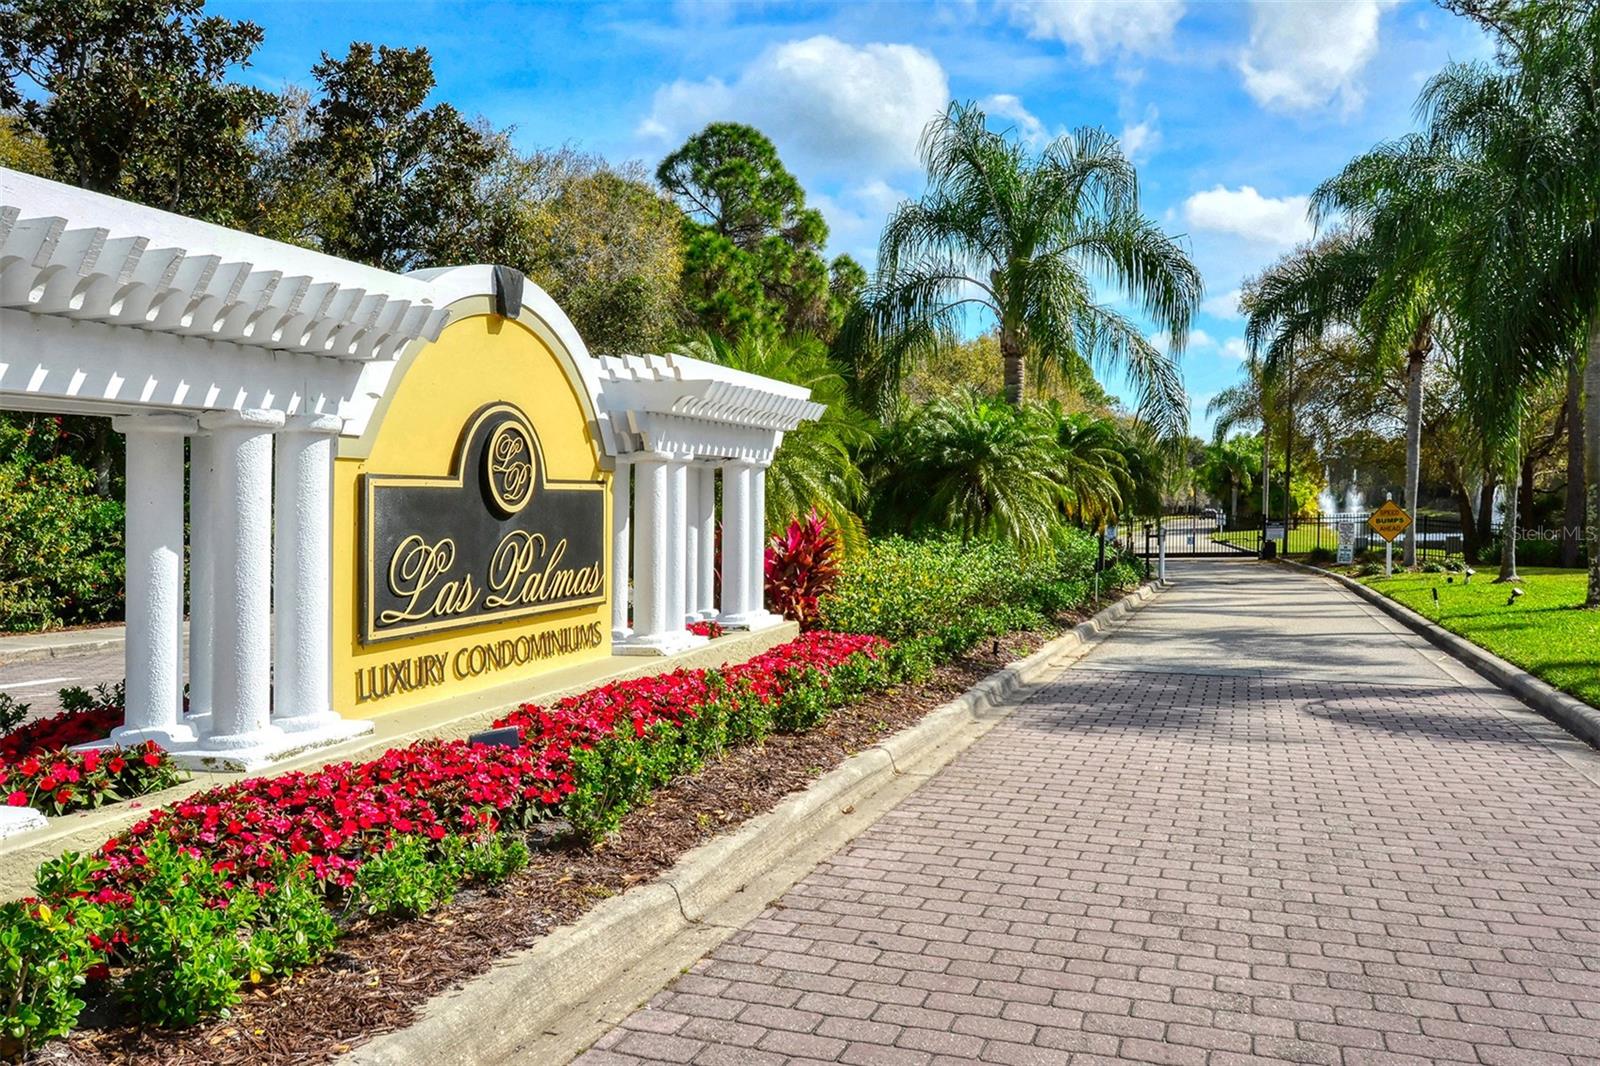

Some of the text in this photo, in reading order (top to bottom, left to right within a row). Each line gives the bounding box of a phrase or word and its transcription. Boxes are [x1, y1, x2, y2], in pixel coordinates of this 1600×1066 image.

[380, 530, 604, 623] Las Palmas
[355, 621, 602, 702] LUXURY CONDOMINIUMS
